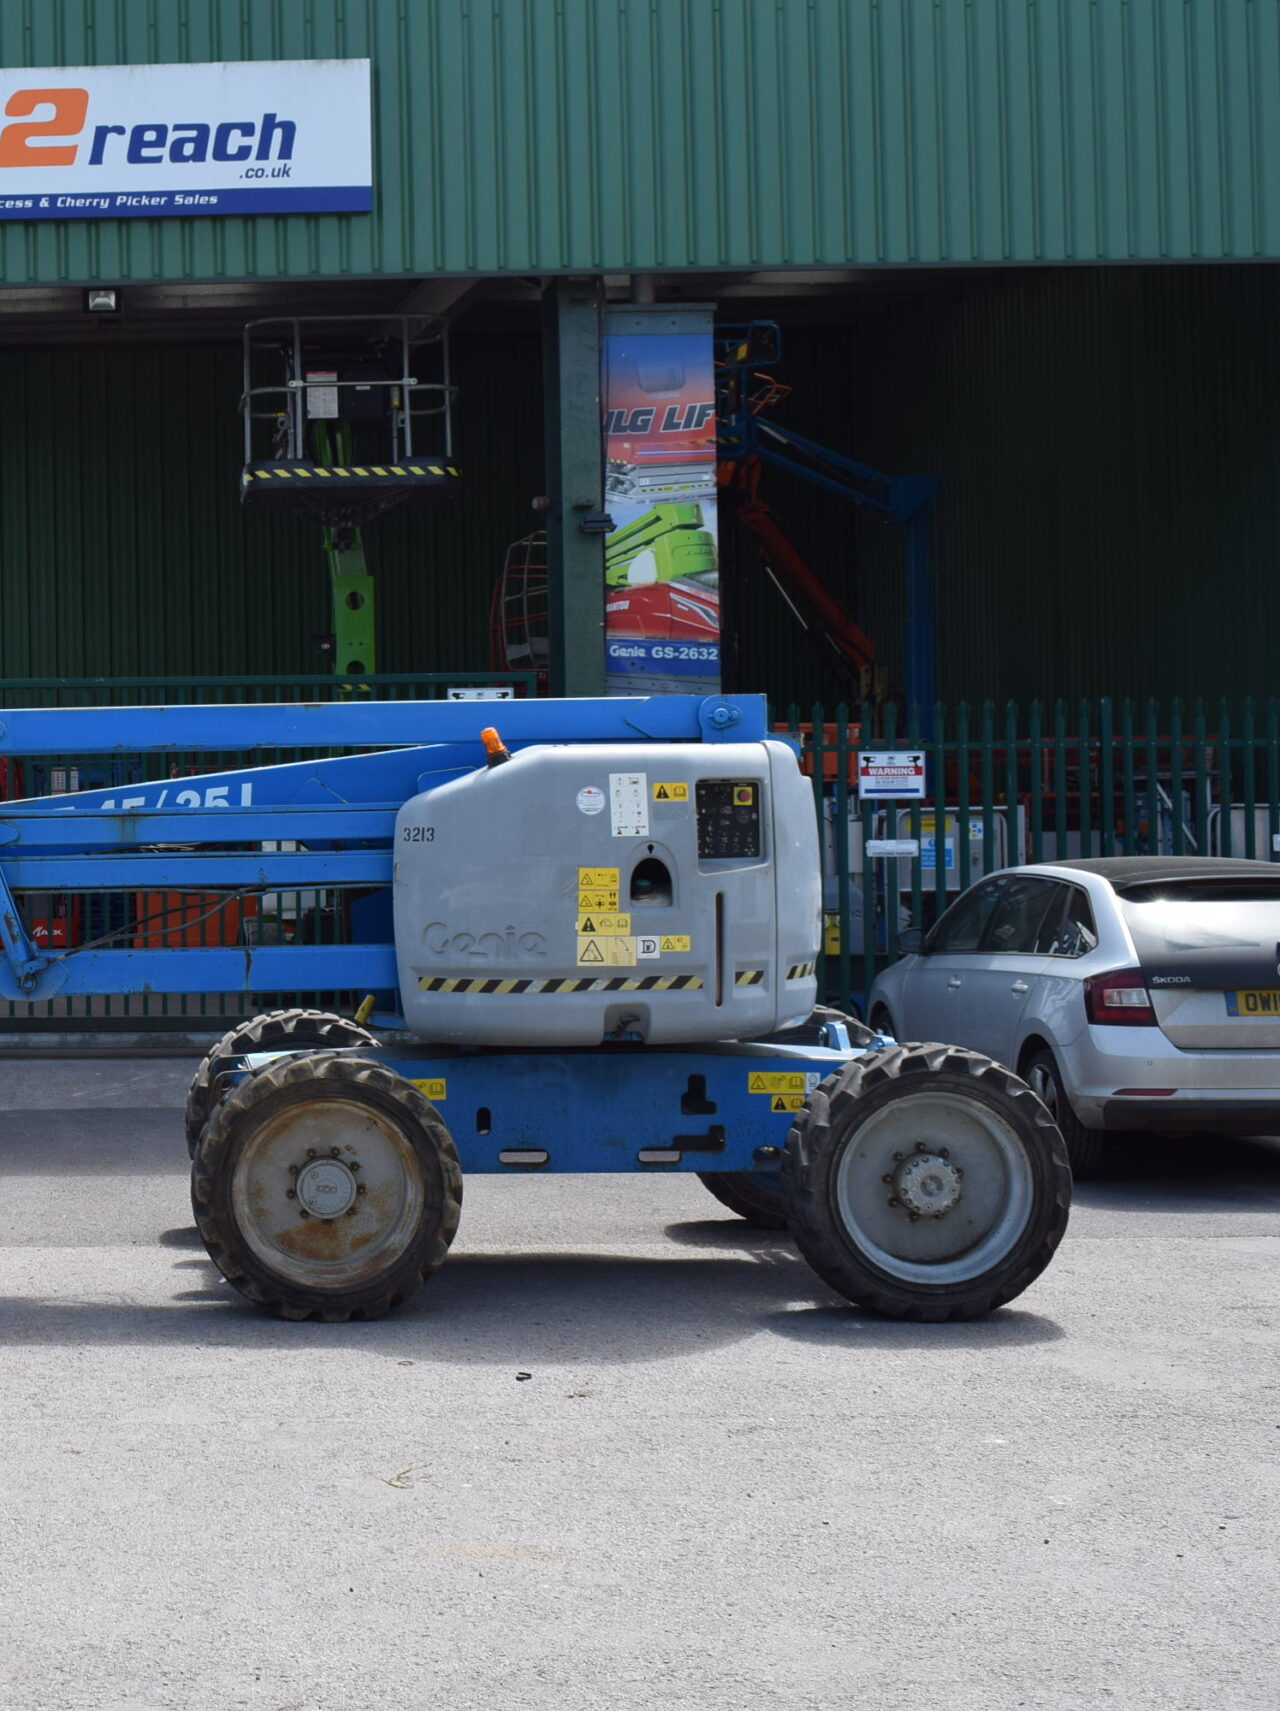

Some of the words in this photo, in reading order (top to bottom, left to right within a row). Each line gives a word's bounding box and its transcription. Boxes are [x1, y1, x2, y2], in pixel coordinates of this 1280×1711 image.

[238, 163, 292, 179] .co.uk
[38, 197, 50, 208] &
[56, 196, 110, 209] Cherry
[115, 195, 168, 207] Picker
[174, 194, 219, 205] Sales
[609, 645, 647, 658] Genie
[651, 646, 718, 660] GS-2632
[867, 767, 916, 776] WARNING
[403, 827, 436, 842] 3213
[422, 921, 547, 960] Genie
